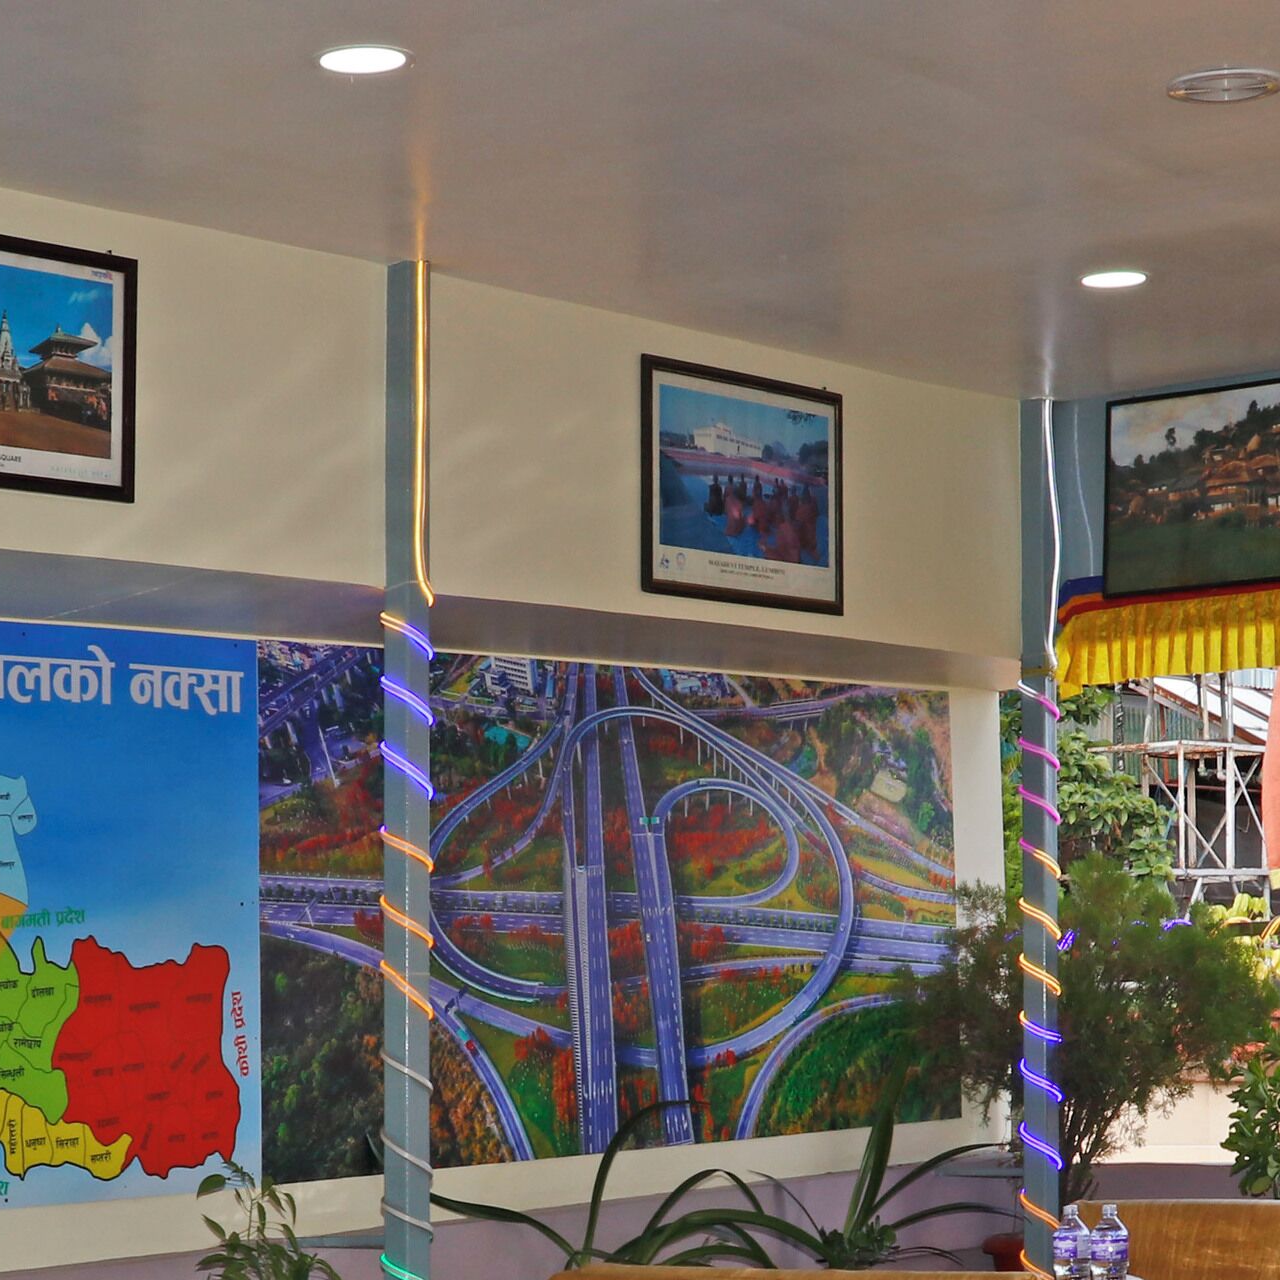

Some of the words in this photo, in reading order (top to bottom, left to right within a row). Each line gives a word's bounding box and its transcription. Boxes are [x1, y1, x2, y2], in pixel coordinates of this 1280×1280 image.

[129, 663, 244, 715] नक्सा
[230, 991, 245, 1029] प्रदेश
[234, 1035, 249, 1077] कोशी
